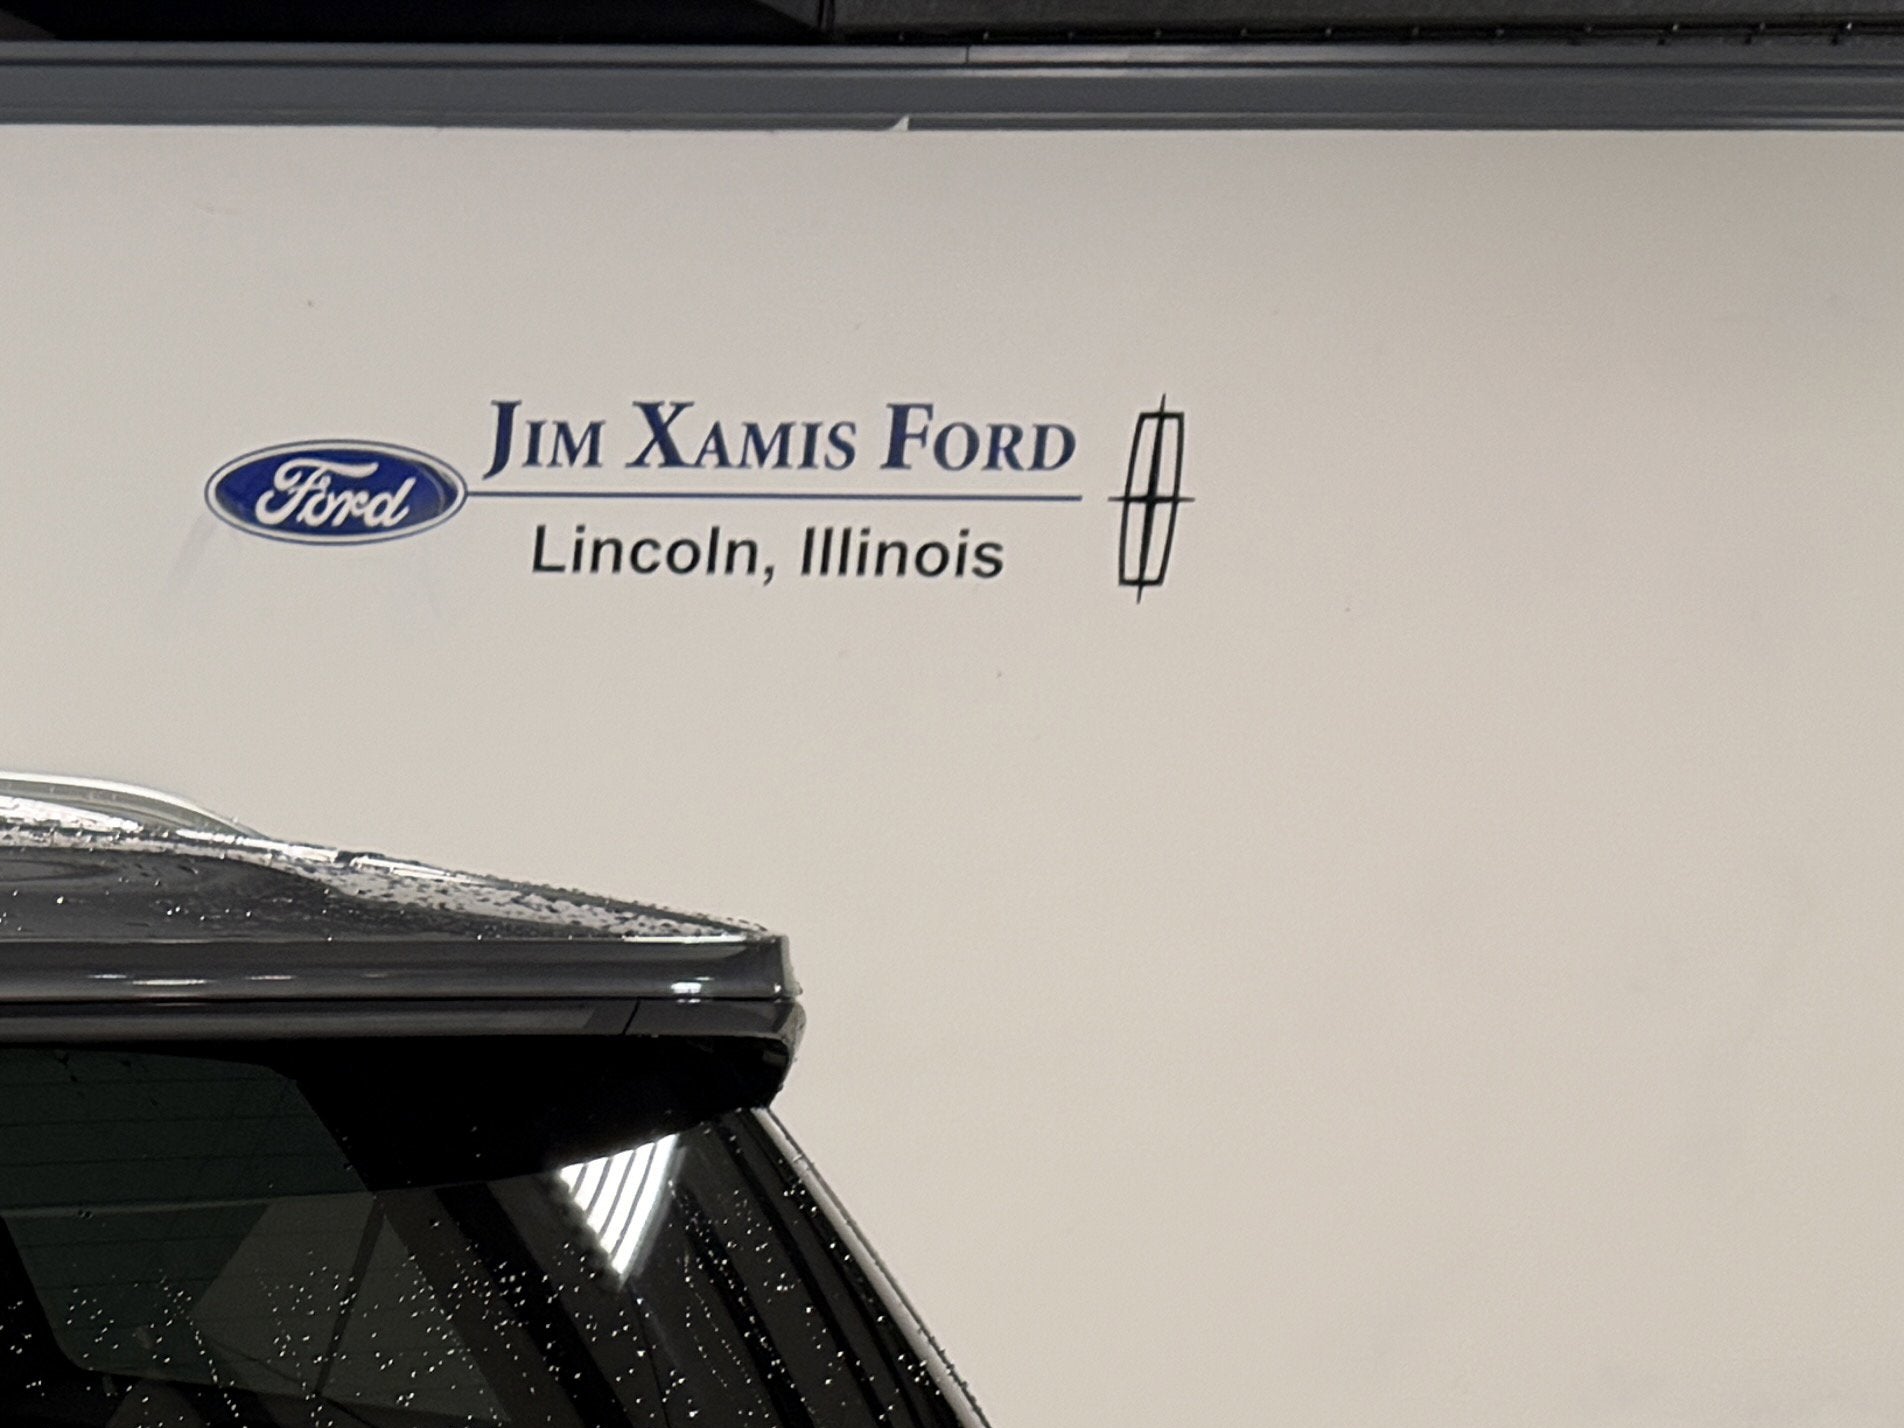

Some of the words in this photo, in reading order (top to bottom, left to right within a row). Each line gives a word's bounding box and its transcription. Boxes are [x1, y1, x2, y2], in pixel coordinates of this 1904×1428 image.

[483, 399, 606, 480] JIM
[625, 401, 856, 473] XAMIS
[880, 401, 1077, 473] FORD
[254, 458, 416, 530] Ford
[530, 525, 777, 586] Lincoln,
[799, 526, 1005, 580] Illinois
